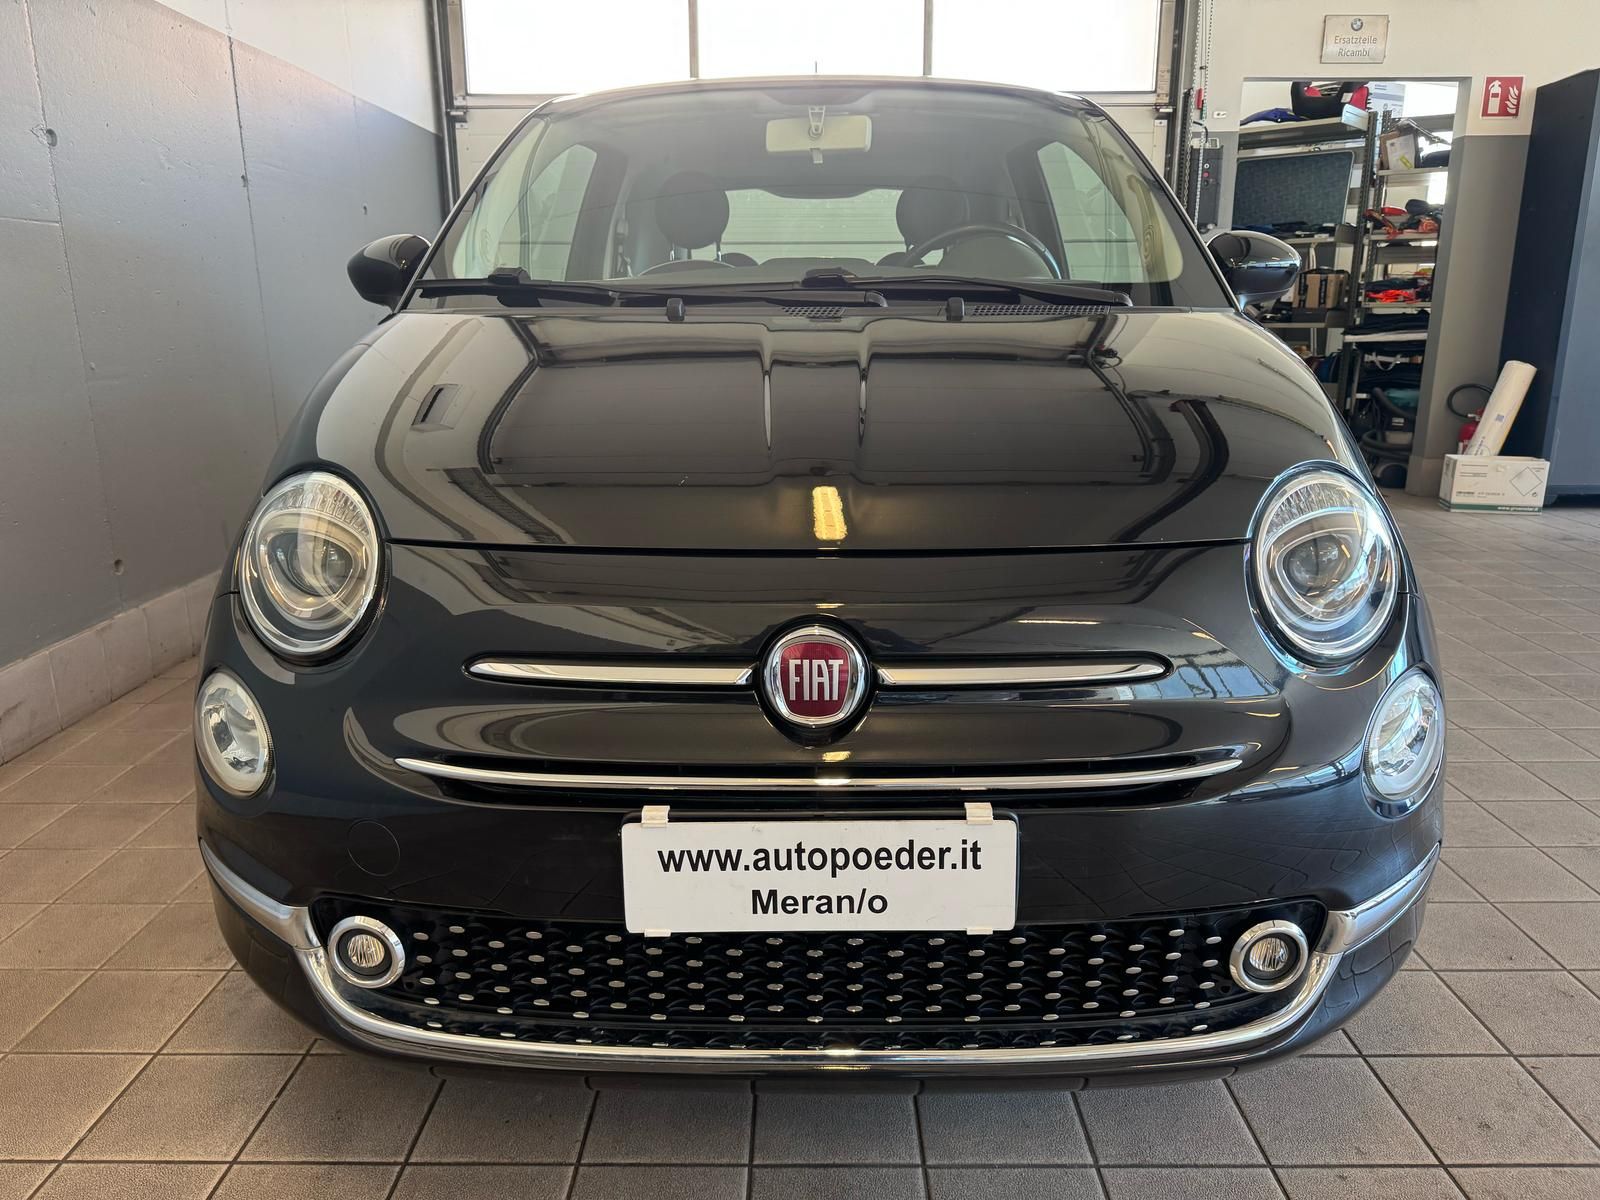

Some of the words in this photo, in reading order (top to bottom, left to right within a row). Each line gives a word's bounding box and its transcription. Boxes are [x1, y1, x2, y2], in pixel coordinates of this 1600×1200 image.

[1334, 35, 1378, 45] Ersatzteile
[1337, 47, 1371, 57] Ricambi
[788, 658, 844, 701] FIAT
[657, 839, 982, 878] www.autopoeder.it
[751, 888, 889, 915] Meran/o
